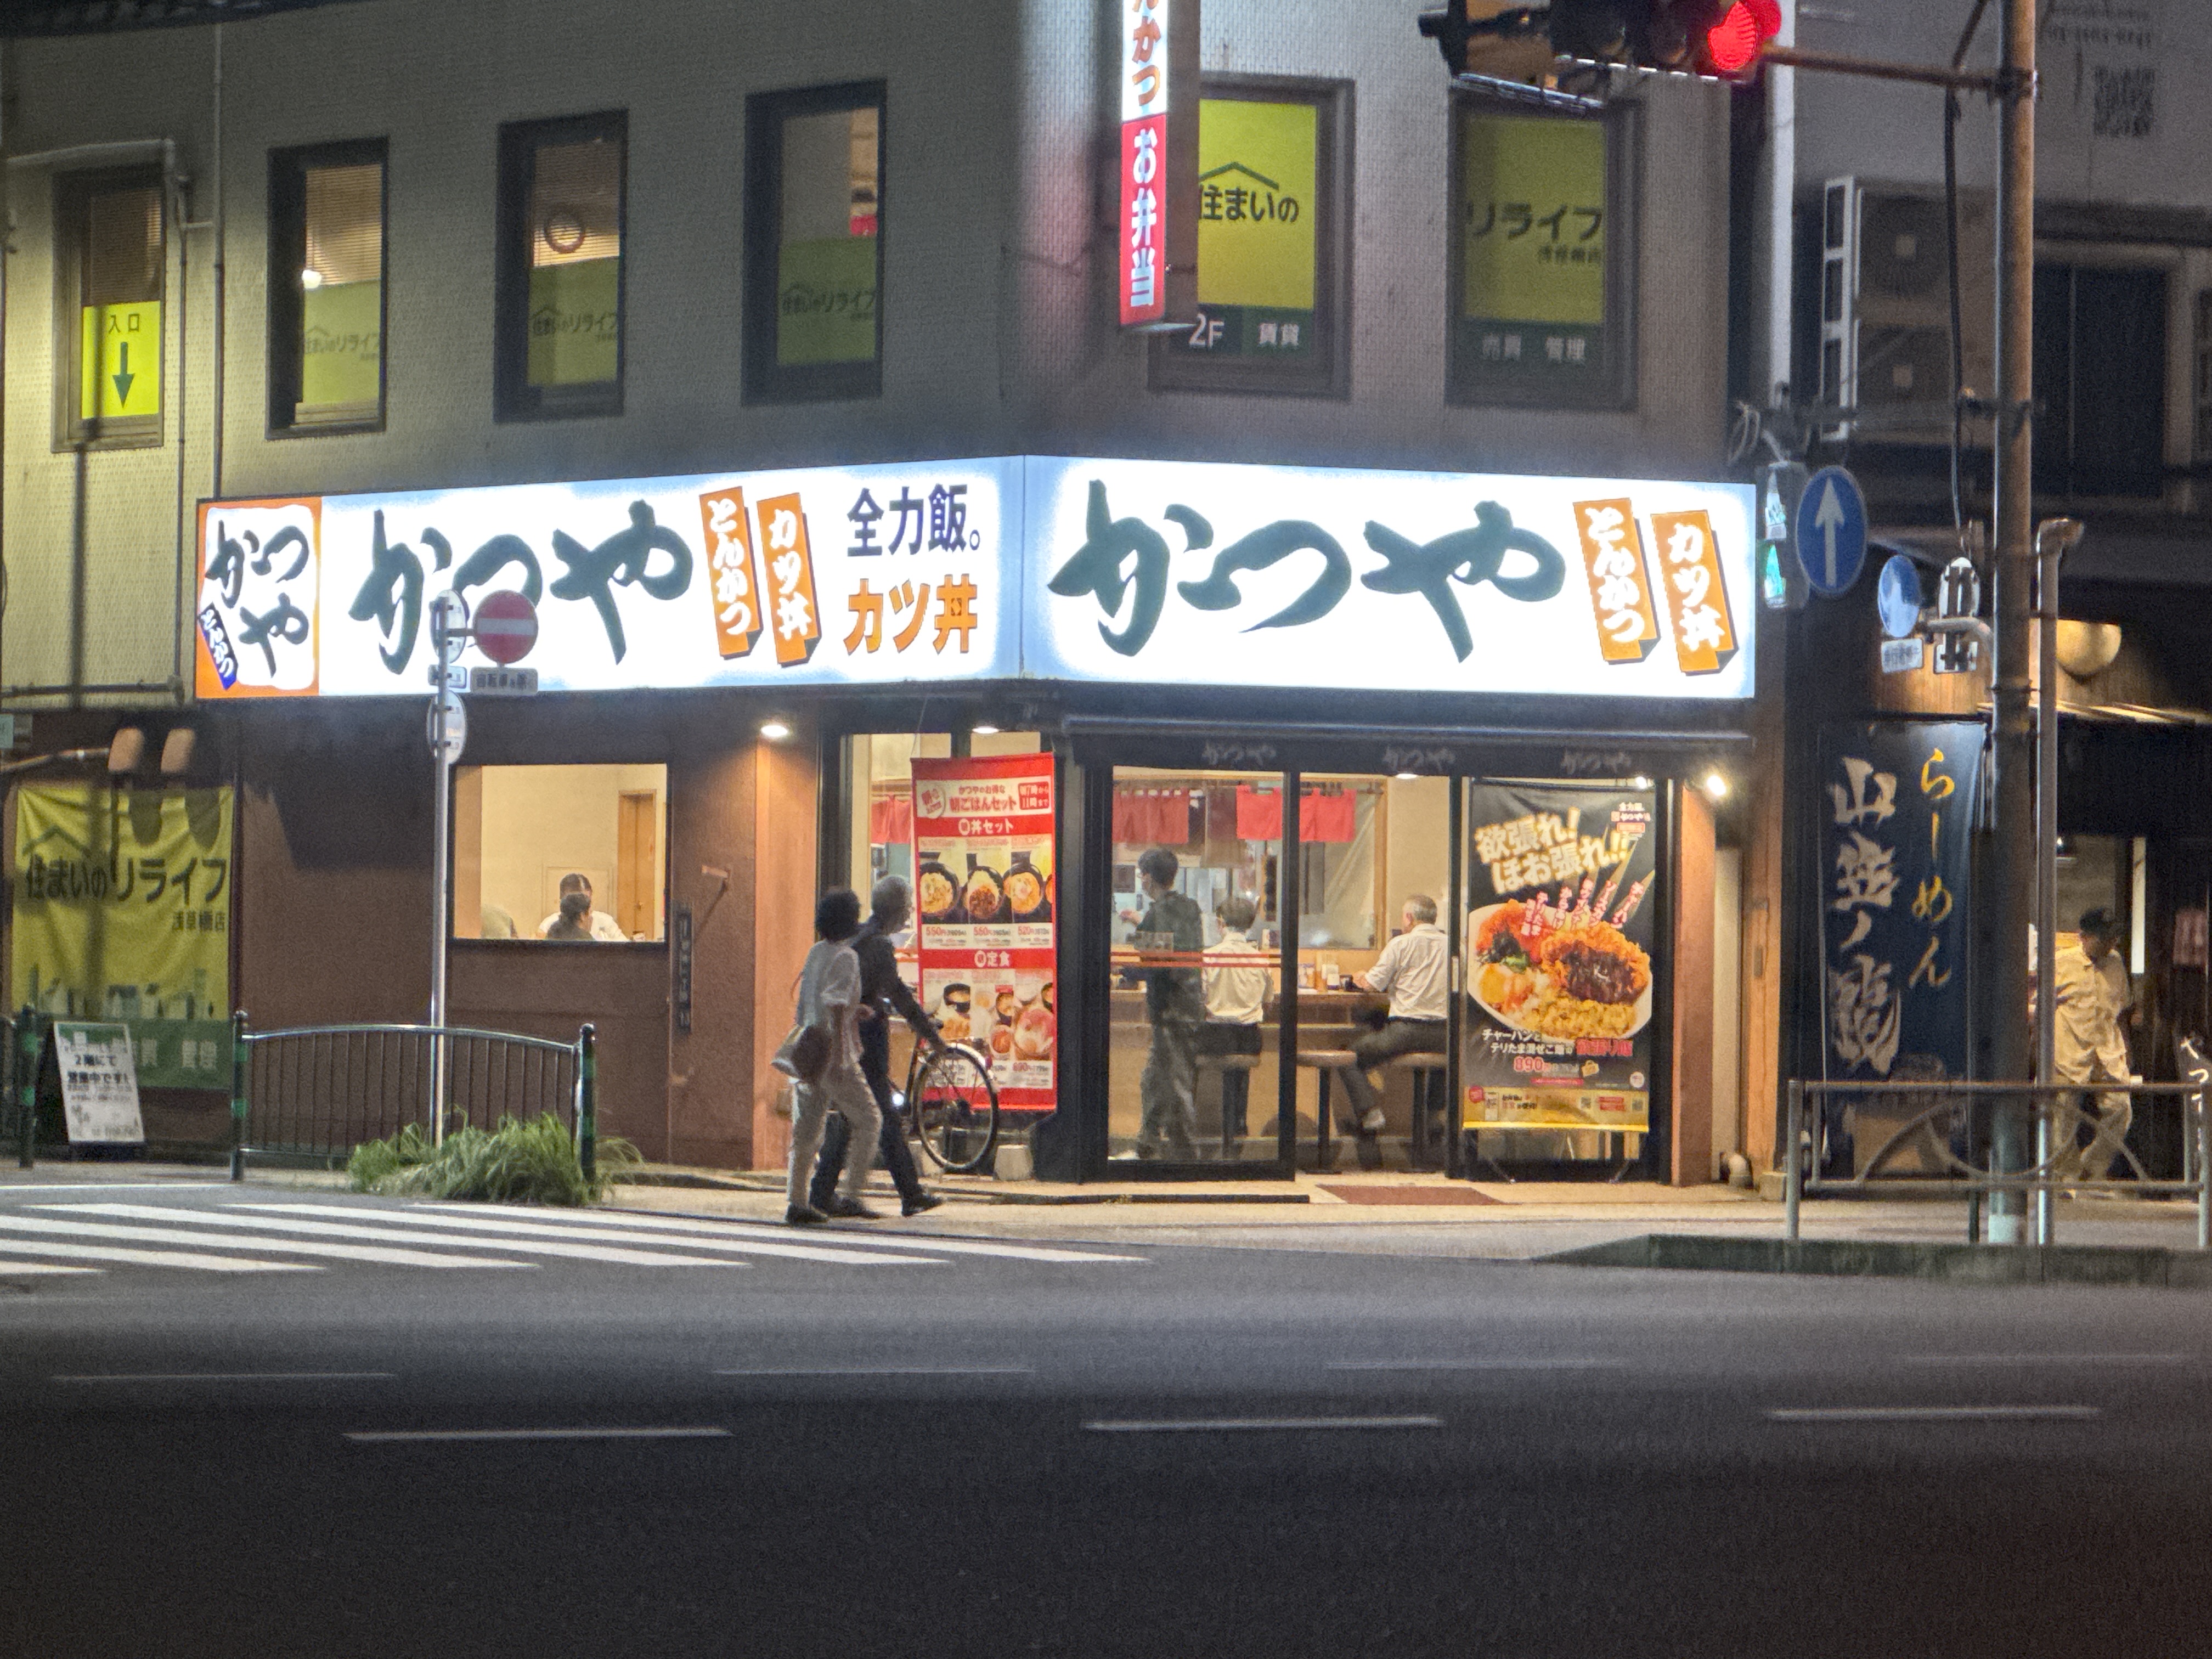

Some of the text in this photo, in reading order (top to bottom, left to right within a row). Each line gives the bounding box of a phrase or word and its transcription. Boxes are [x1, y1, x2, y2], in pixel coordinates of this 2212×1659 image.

[1131, 127, 1158, 307] お弁当
[108, 313, 141, 334] 入口
[1188, 313, 1225, 349] 2F
[707, 498, 752, 635] とんかつ
[769, 509, 812, 641] カツ丼
[847, 483, 980, 557] 全力飯。
[1047, 478, 1566, 664] かつや
[1584, 505, 1645, 643] とんかつ
[348, 499, 693, 675] かつや
[842, 573, 978, 656] カツ丼
[1668, 522, 1725, 651] カツ丼
[949, 795, 1017, 812] 朝ごはんセット
[1909, 747, 1955, 988] らーめん
